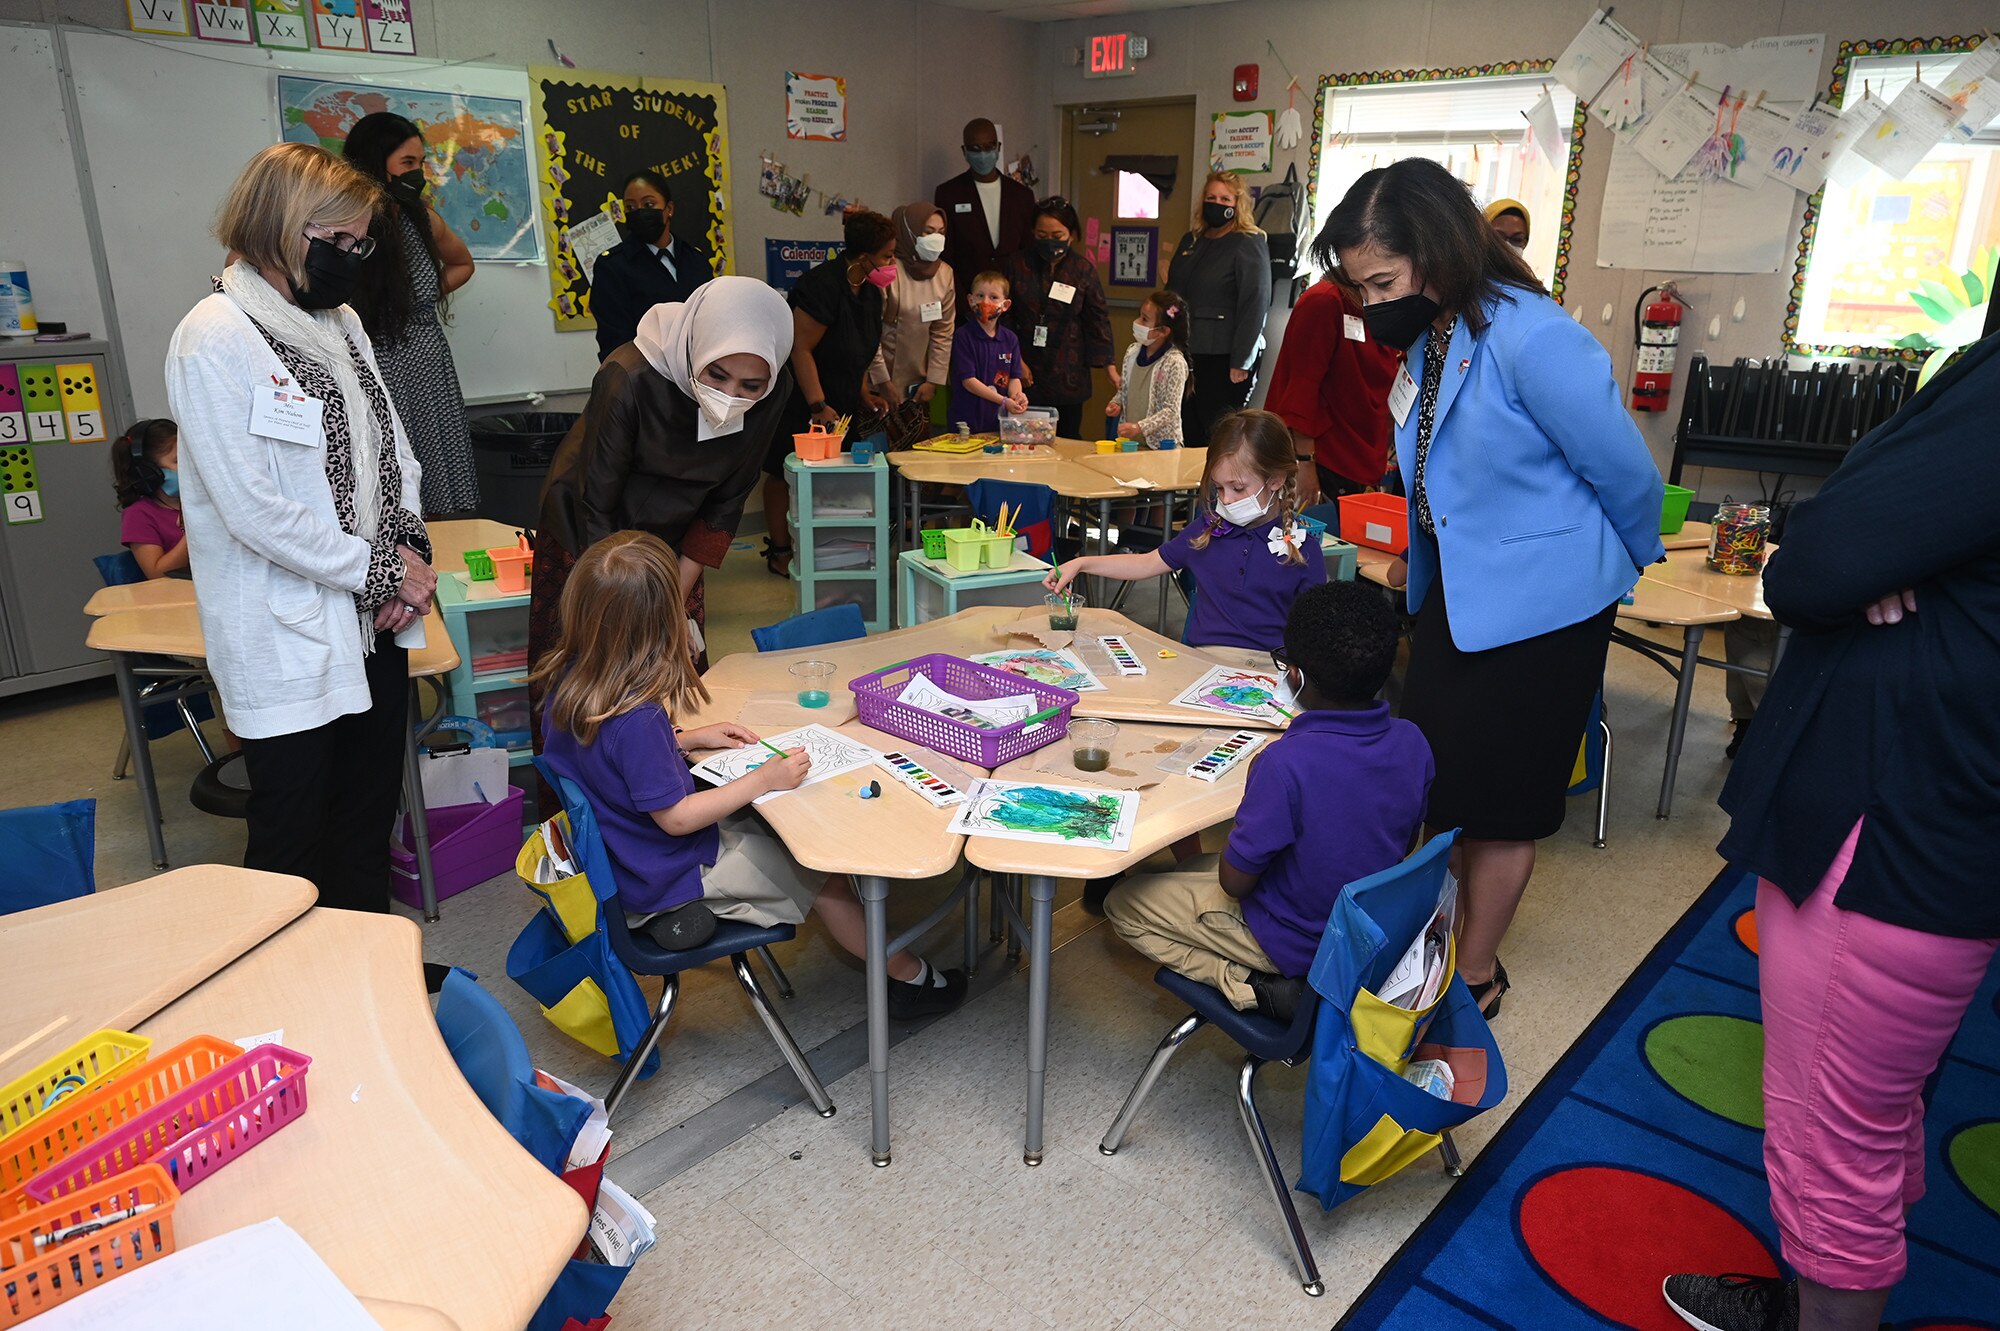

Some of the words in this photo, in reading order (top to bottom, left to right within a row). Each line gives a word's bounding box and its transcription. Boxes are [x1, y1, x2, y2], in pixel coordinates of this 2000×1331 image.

[1091, 34, 1127, 73] EXIT
[804, 90, 829, 98] PRACTICE
[566, 91, 613, 114] STAR
[633, 95, 706, 131] STUDENT
[619, 124, 640, 139] OF
[575, 150, 606, 177] THE
[781, 247, 825, 260] Calendar
[0, 416, 17, 439] 3
[38, 415, 56, 437] 4
[77, 414, 94, 436] 5
[14, 495, 33, 517] 9
[604, 1228, 624, 1254] Alive!
